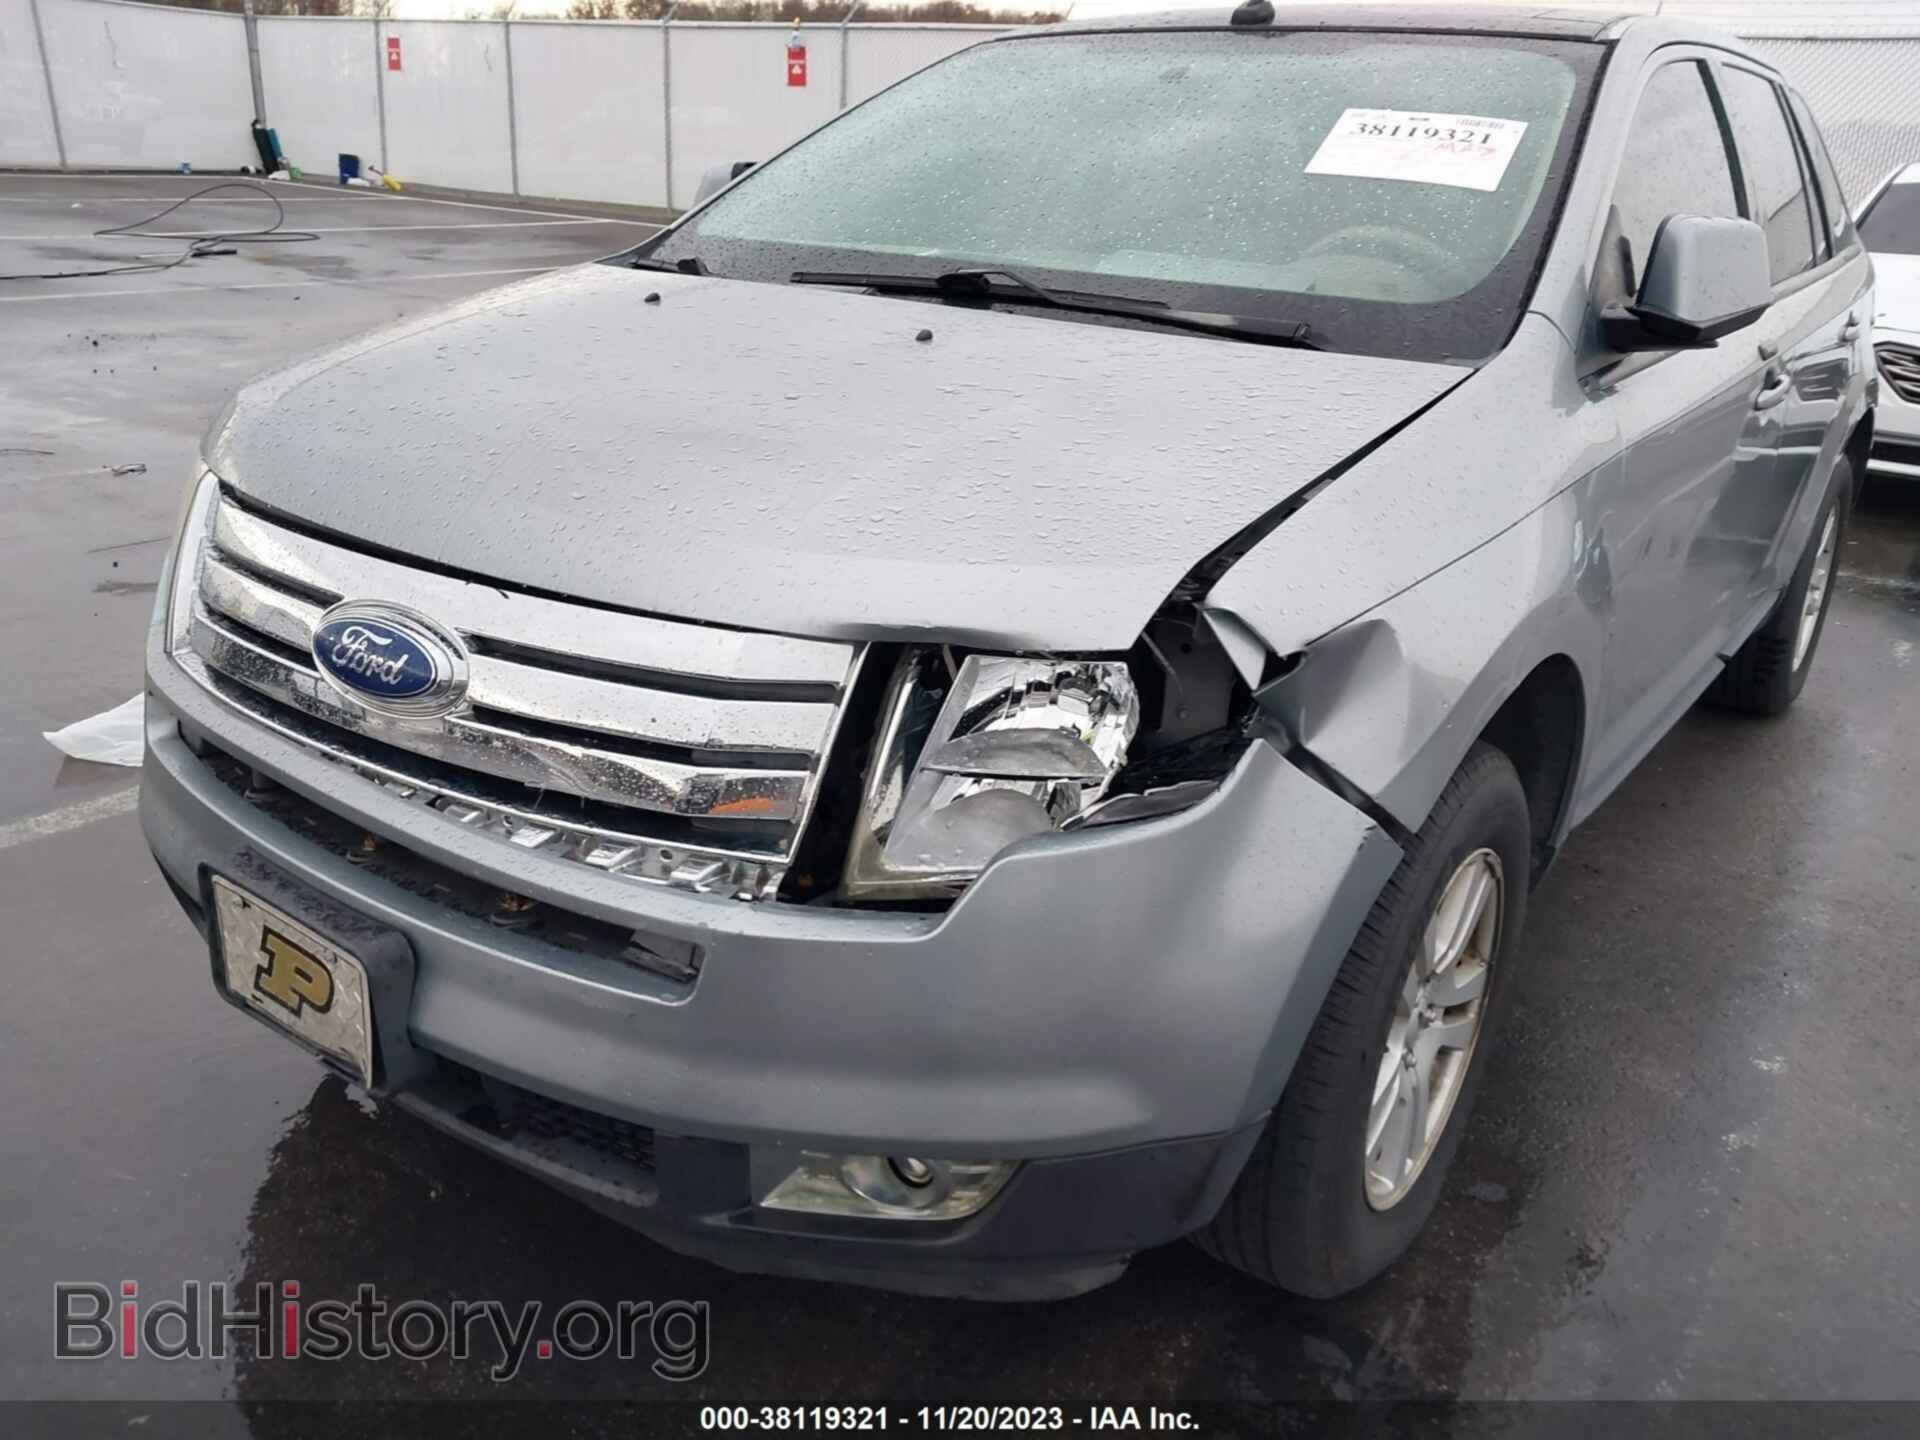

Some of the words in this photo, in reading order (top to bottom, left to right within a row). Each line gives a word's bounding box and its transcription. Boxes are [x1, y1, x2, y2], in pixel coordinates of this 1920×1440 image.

[1353, 122, 1492, 145] 38119321
[331, 625, 409, 686] Ford
[254, 924, 335, 1019] P
